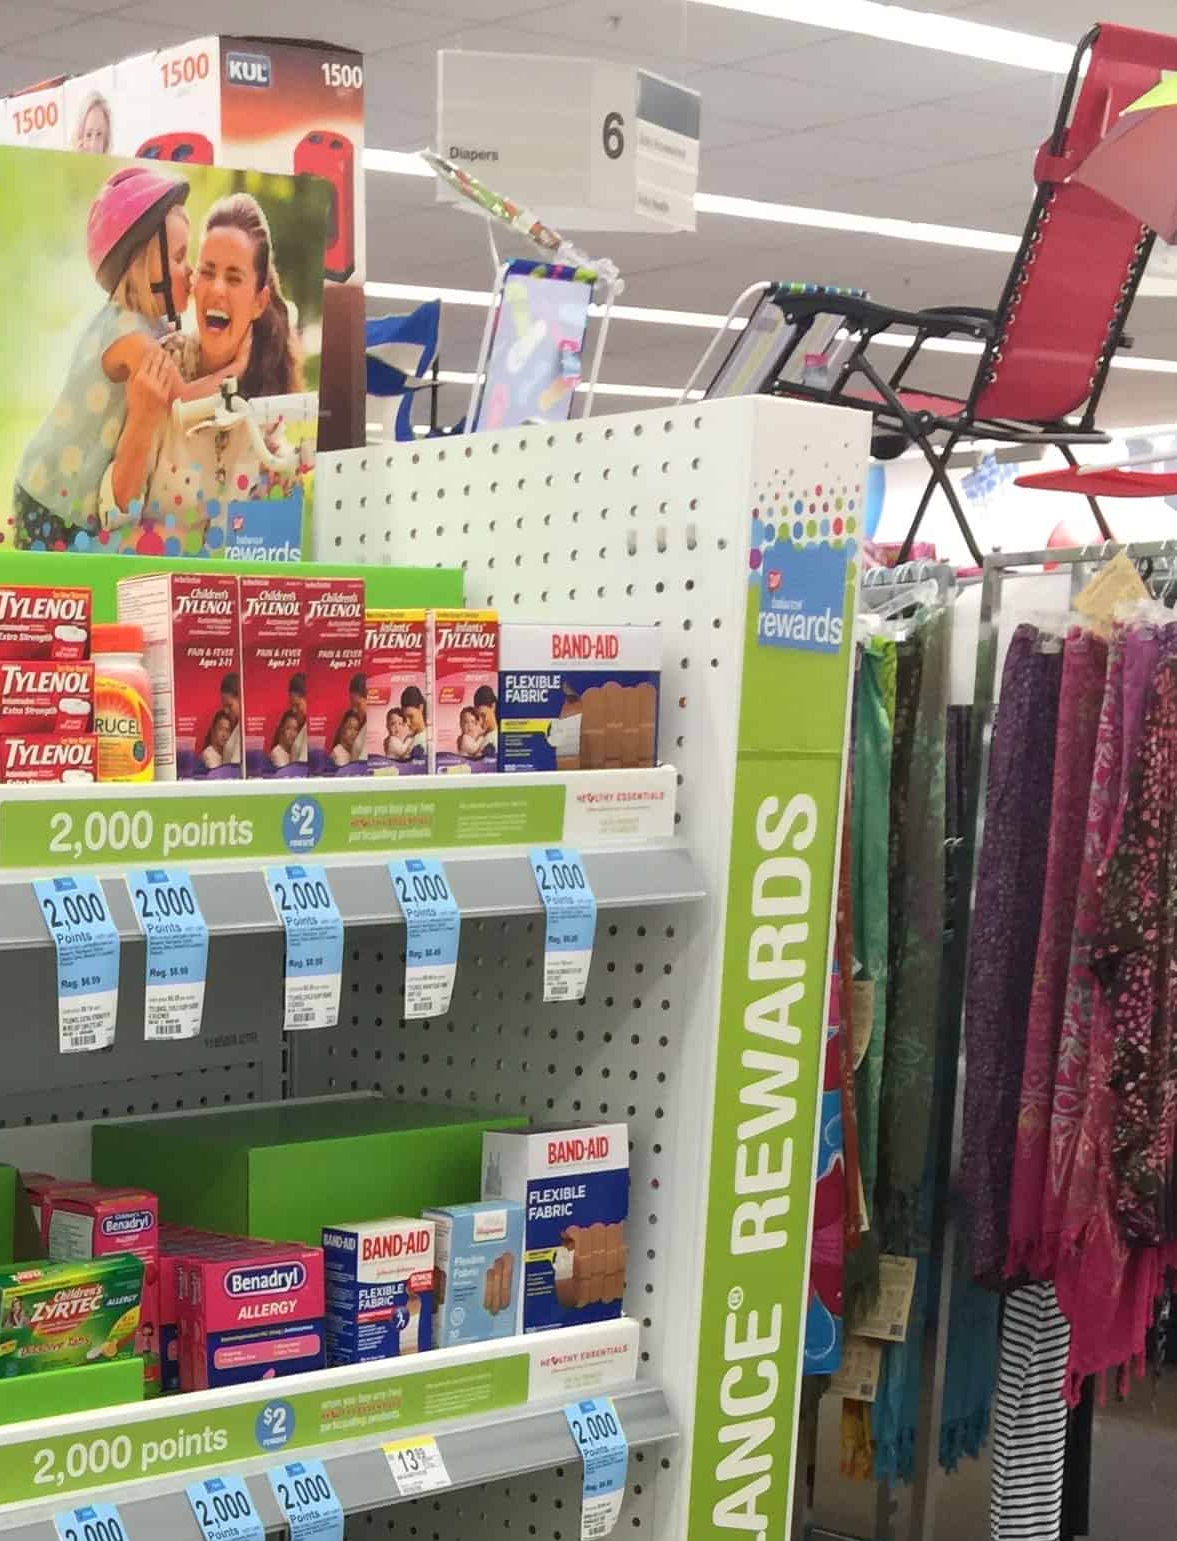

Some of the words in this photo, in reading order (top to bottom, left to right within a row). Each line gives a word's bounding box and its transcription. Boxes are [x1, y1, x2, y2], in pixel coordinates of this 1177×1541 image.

[160, 53, 210, 88] 1500
[229, 56, 269, 84] KUL
[321, 62, 363, 90] 1500
[13, 102, 58, 135] 1500
[601, 111, 625, 160] 6
[449, 145, 499, 164] Diapers
[224, 543, 302, 563] rewards
[176, 596, 233, 614] TYLENOL
[245, 598, 300, 617] TYLENOL
[307, 600, 363, 618] TYLENOL
[364, 630, 423, 649] TYLENOL
[437, 630, 496, 649] TYLENOL
[757, 607, 842, 644] rewards
[551, 634, 619, 659] BAND-AID
[1, 665, 90, 694] TYLENOL
[505, 675, 561, 691] FLEXIBLE
[505, 690, 549, 704] FABRIC
[5, 739, 94, 767] TYLENOL
[290, 803, 315, 836] $2
[49, 810, 153, 858] 2,000
[163, 814, 253, 855] points
[395, 874, 448, 905] 2,000
[536, 864, 585, 896] 2,000
[43, 893, 105, 930] 2,000
[136, 887, 195, 922] 2,000
[275, 881, 331, 914] 2,000
[57, 931, 92, 944] Points
[147, 922, 181, 934] Points
[730, 793, 817, 1256] REWARDS
[548, 1137, 609, 1165] BAND-AID
[529, 1185, 586, 1204] FLEXIBLE
[102, 1215, 150, 1233] Benadryl
[529, 1203, 573, 1220] FABRIC
[323, 1234, 356, 1250] BAND-AID
[361, 1231, 430, 1262] BAND-AID
[55, 1284, 104, 1301] Children's
[231, 1265, 299, 1293] Benadryl
[358, 1283, 404, 1301] FLEXIBLE
[31, 1295, 103, 1322] ZYRTEC
[238, 1299, 297, 1321] ALLERGY
[358, 1295, 394, 1310] FABRIC
[263, 1406, 286, 1434] $2
[573, 1413, 618, 1444] 2,000
[33, 1435, 132, 1487] 2,000
[141, 1426, 228, 1470] points
[277, 1475, 331, 1510] 2,000
[195, 1490, 251, 1528] 2,000
